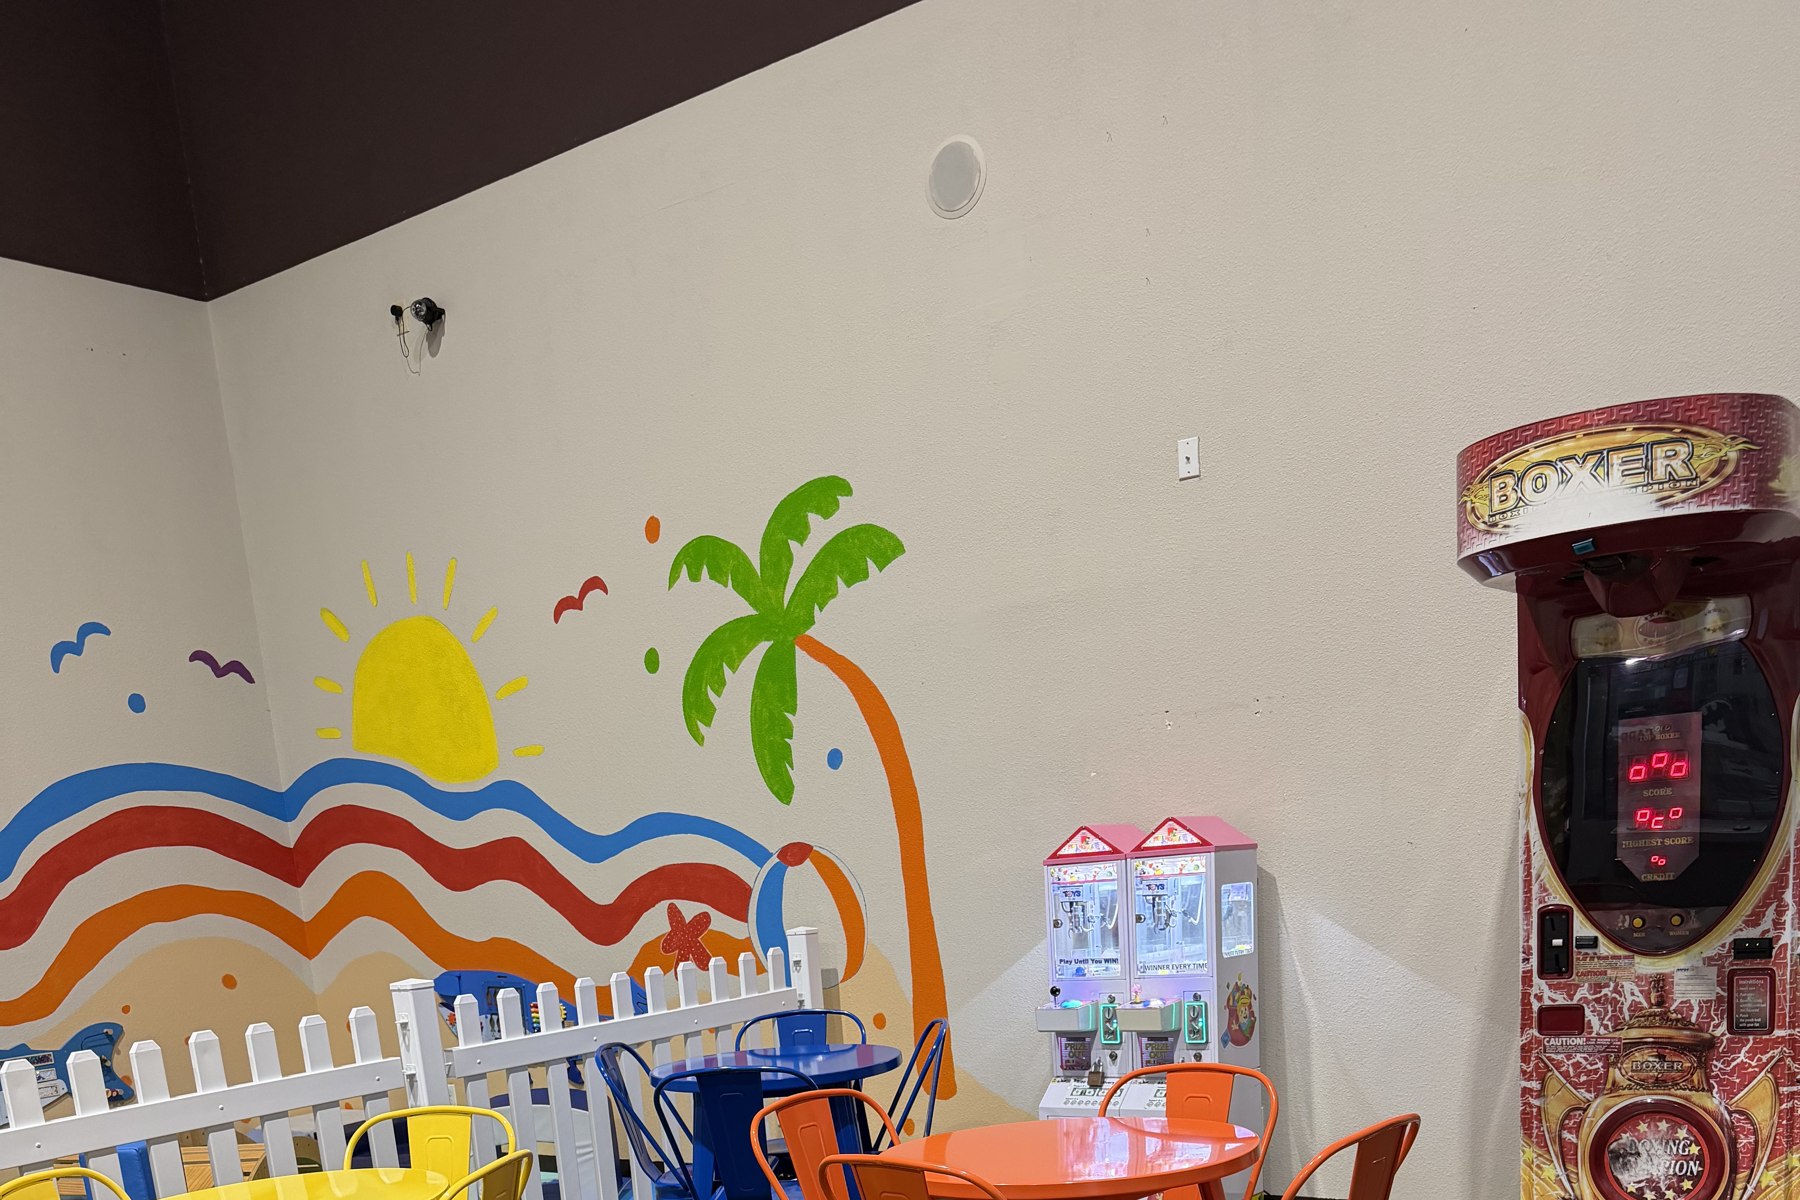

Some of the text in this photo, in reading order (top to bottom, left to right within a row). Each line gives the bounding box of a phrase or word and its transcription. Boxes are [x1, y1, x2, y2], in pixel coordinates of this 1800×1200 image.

[1488, 438, 1698, 515] BOXER
[1642, 787, 1673, 797] SCORE
[1664, 836, 1694, 845] SCORE
[1641, 872, 1676, 881] CREDIT
[1145, 883, 1166, 891] TOYS
[1059, 958, 1073, 966] Play
[1544, 1037, 1586, 1046] CAUTION!
[1631, 1060, 1684, 1072] BOXER
